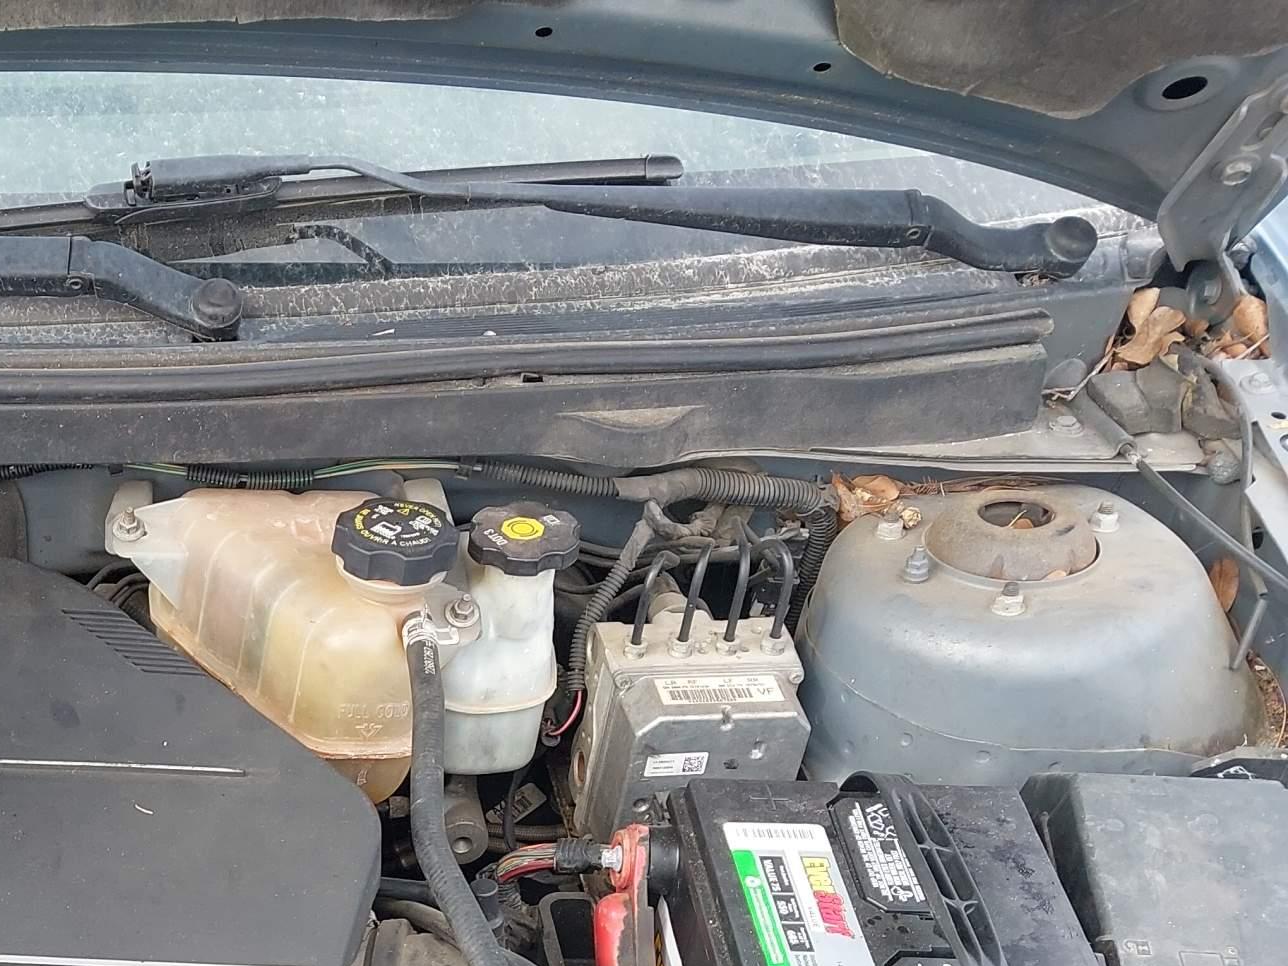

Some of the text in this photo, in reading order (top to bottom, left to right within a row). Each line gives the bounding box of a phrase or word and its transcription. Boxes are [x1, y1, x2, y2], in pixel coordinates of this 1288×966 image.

[337, 702, 409, 719] FULL COLD
[800, 855, 856, 939] EverStart
